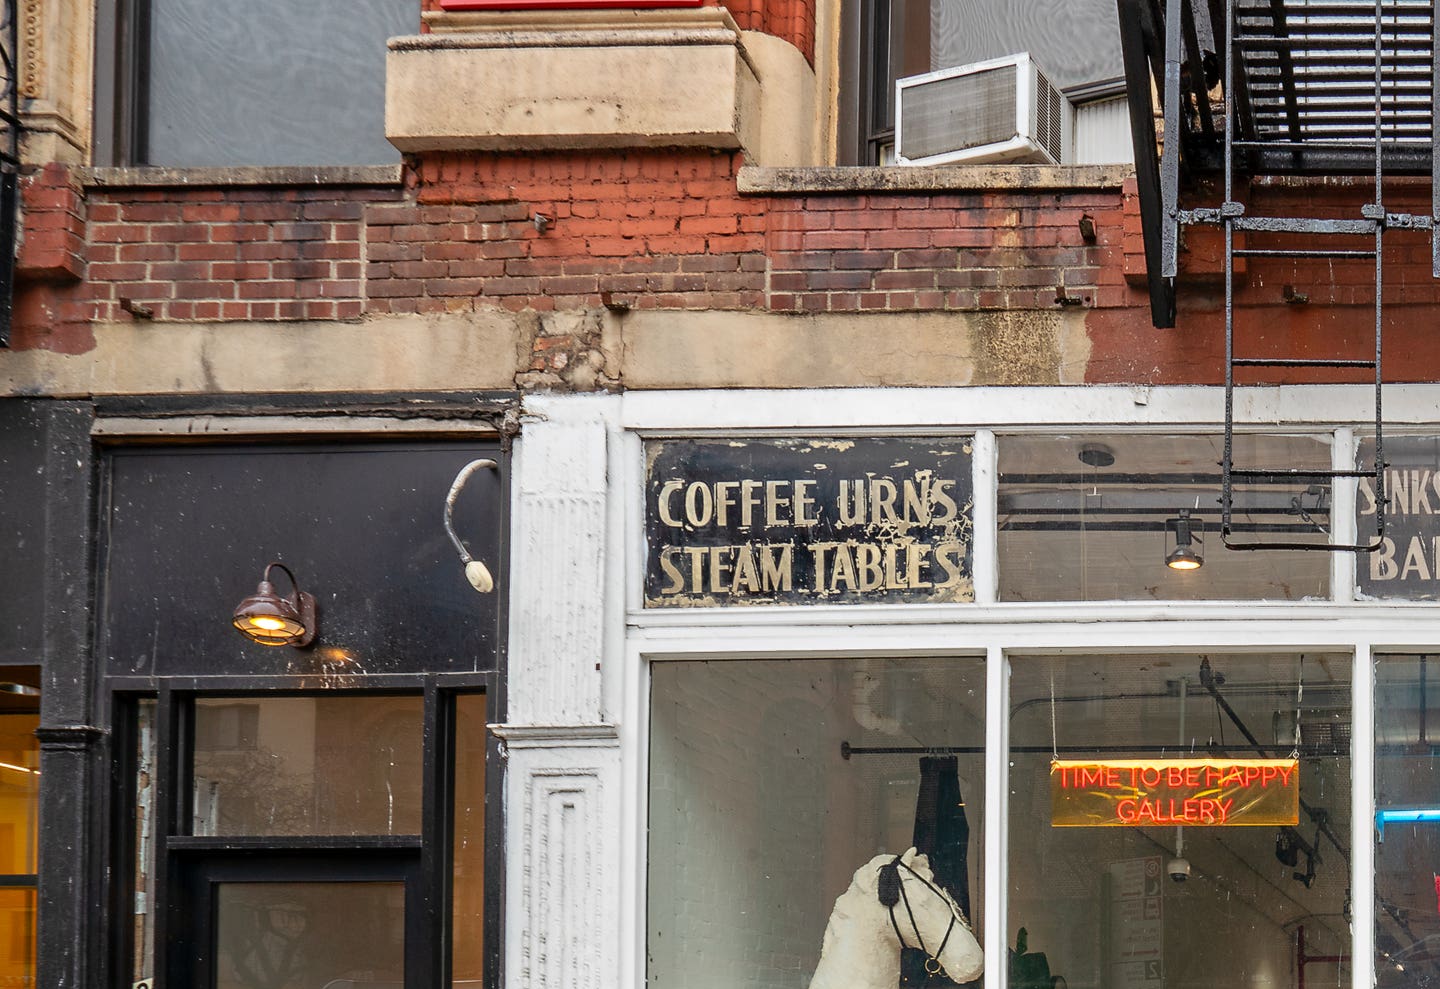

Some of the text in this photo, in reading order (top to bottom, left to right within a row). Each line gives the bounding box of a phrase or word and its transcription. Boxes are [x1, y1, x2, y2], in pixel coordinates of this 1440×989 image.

[658, 477, 958, 528] COFFEE URNS
[659, 544, 967, 595] STEAM TABLES
[1060, 765, 1293, 788] TIME TO BE HAPPY
[1115, 797, 1233, 824] GALLERY
